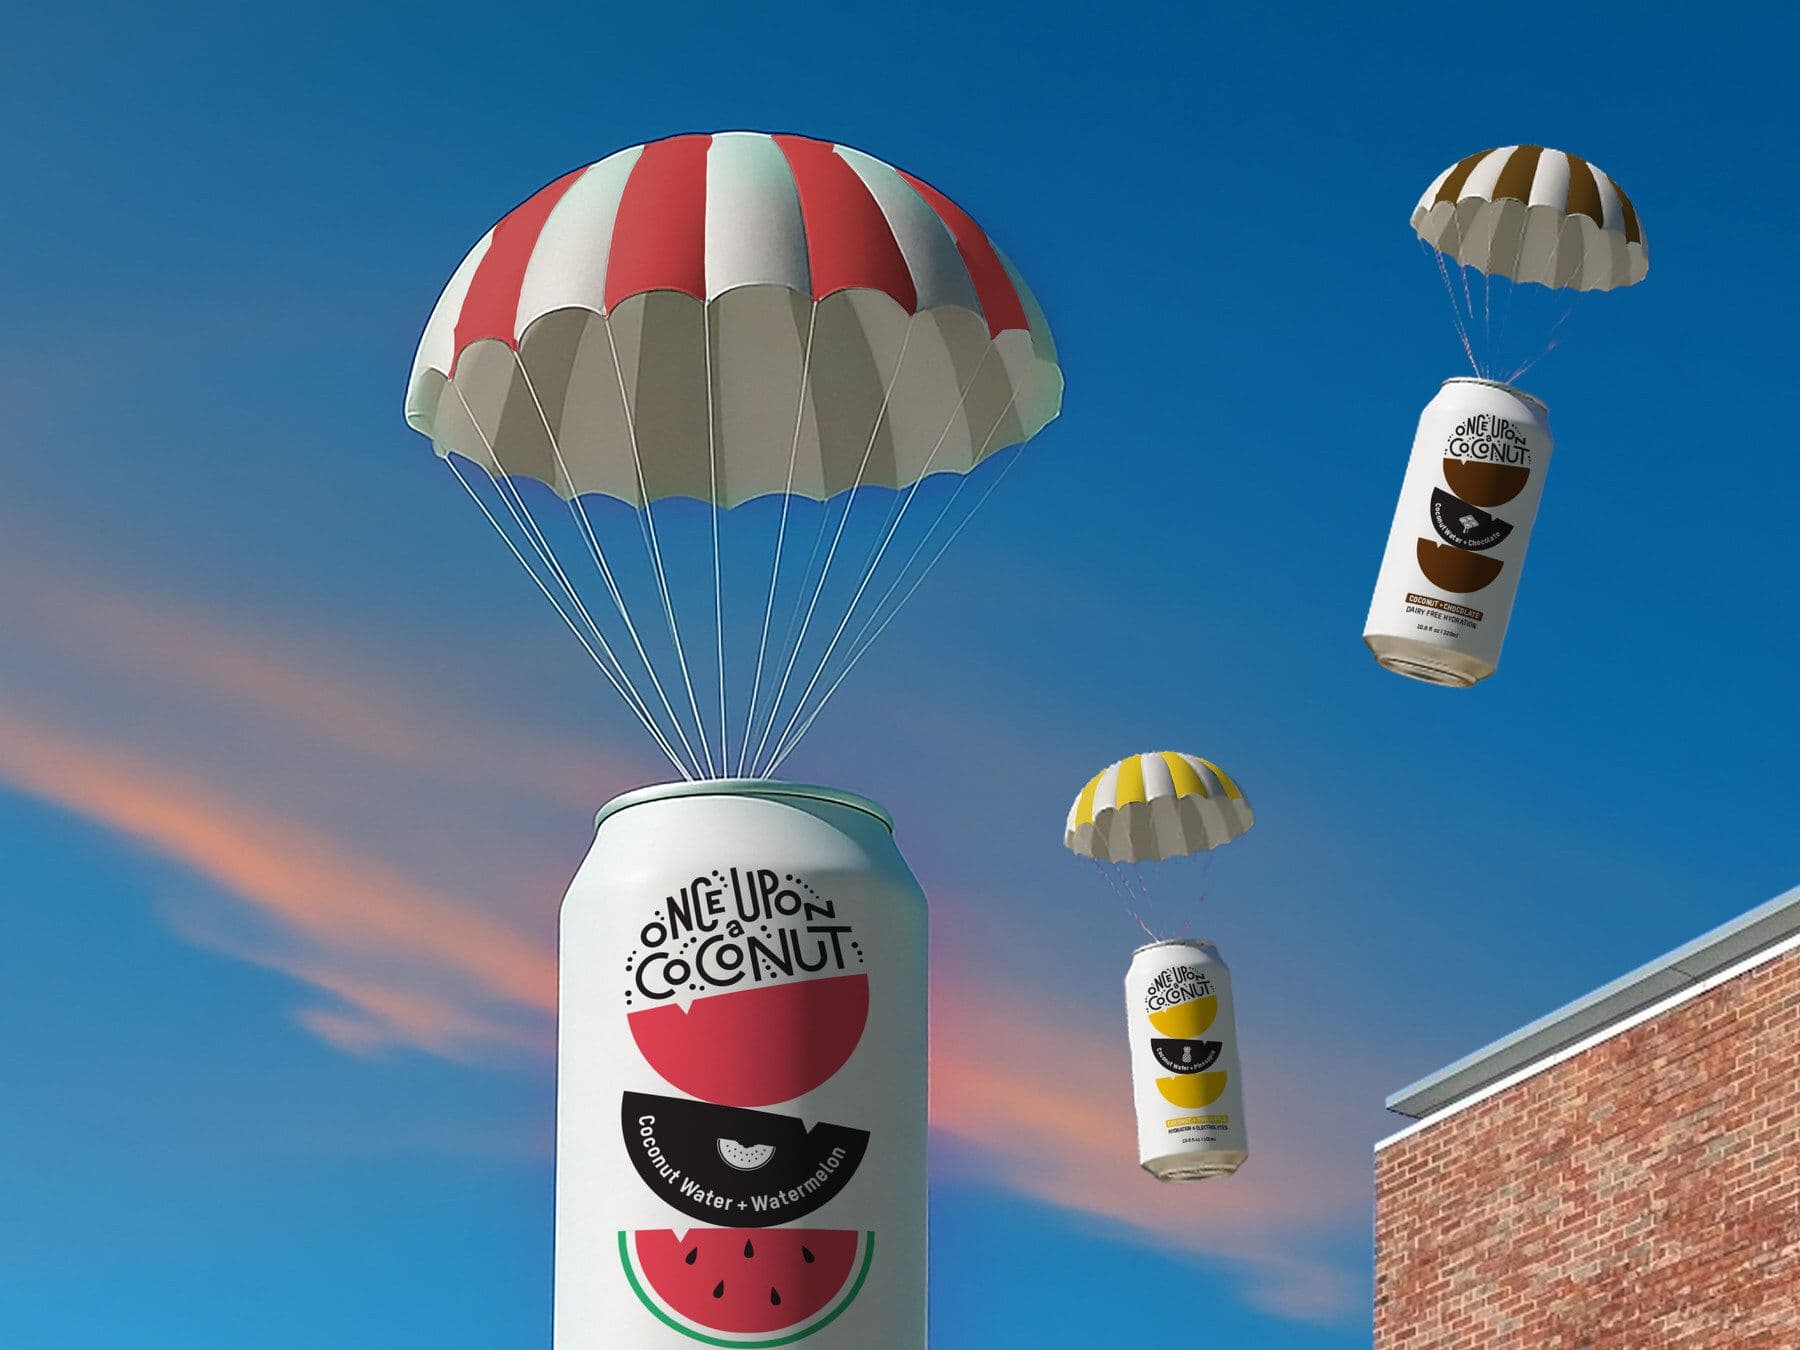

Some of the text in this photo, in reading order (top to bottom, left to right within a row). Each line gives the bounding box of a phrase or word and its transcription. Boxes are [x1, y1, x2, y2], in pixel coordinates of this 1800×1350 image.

[1455, 414, 1526, 445] ONCE UPON
[1486, 434, 1492, 442] a
[1449, 437, 1530, 464] COCONUT
[1435, 502, 1448, 531] Coconut
[1444, 528, 1463, 544] Water
[1468, 531, 1501, 546] Chocolate
[1406, 605, 1477, 629] DAIRY FREE HYDRATION
[1408, 594, 1440, 608] COCONUT
[1443, 602, 1480, 619] CHOCOLATE
[640, 867, 836, 948] ONCE UPON
[726, 919, 745, 938] a
[635, 925, 852, 1000] COCONUT
[1147, 965, 1205, 995] ONCE UPON
[1148, 980, 1210, 1010] COCONUT
[1173, 1063, 1189, 1071] Water
[638, 1114, 847, 1212] Coconut Water + Watermelon
